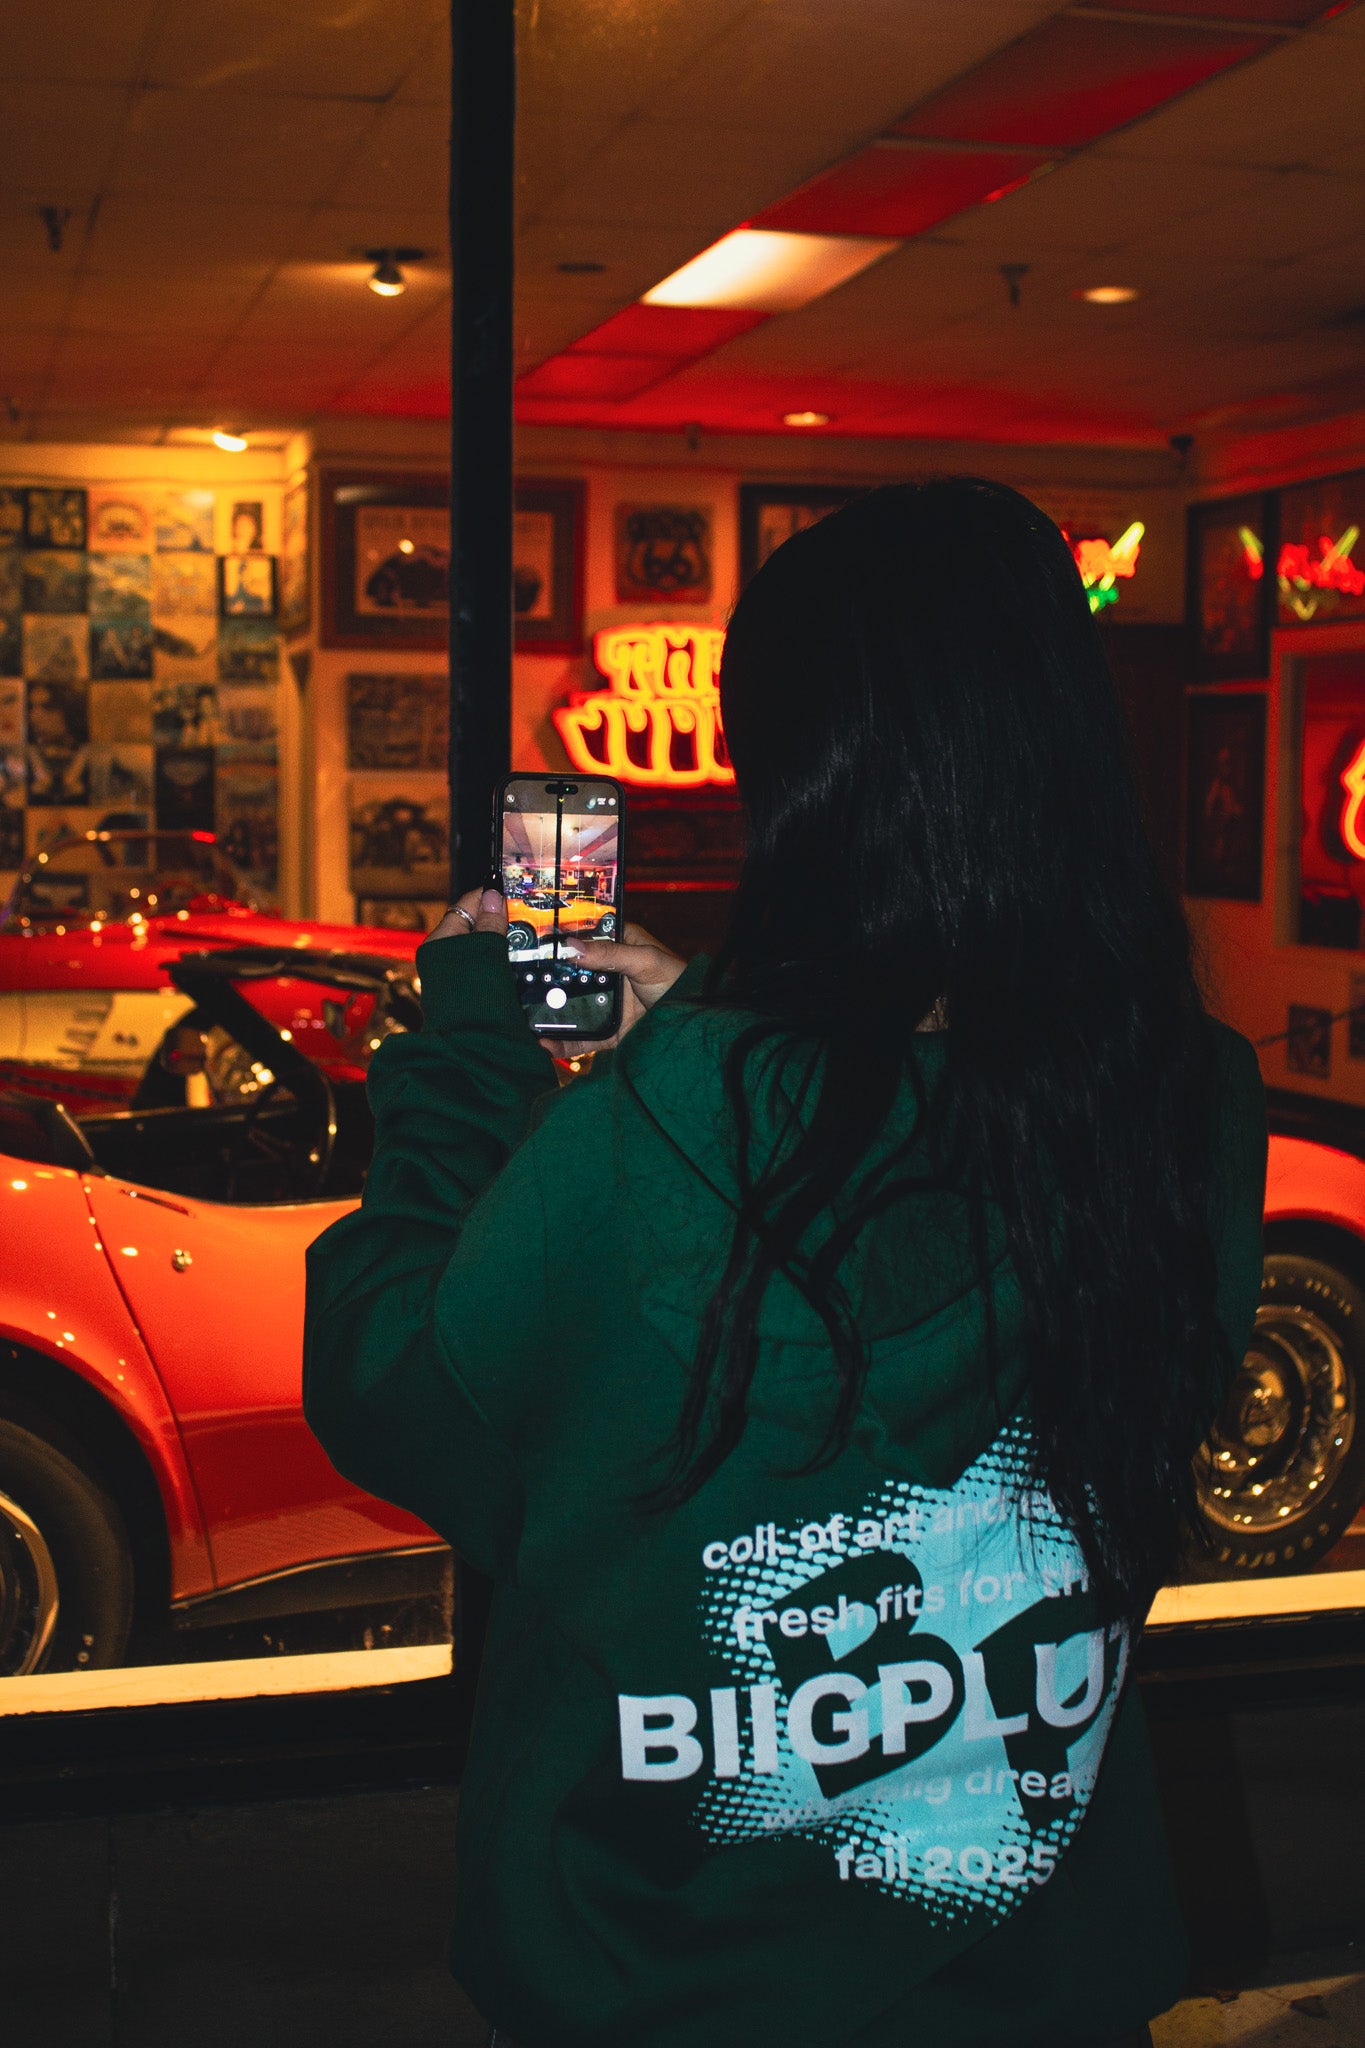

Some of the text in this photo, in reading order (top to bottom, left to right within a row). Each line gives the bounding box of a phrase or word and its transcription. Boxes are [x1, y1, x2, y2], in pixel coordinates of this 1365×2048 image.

[800, 1513, 845, 1552] of
[856, 1505, 924, 1549] art
[733, 1594, 865, 1647] fresh
[876, 1582, 946, 1625] fits
[959, 1569, 1027, 1608] for
[617, 1618, 1130, 1782] BIIGPLU
[834, 1834, 1059, 1886] fall 2025
